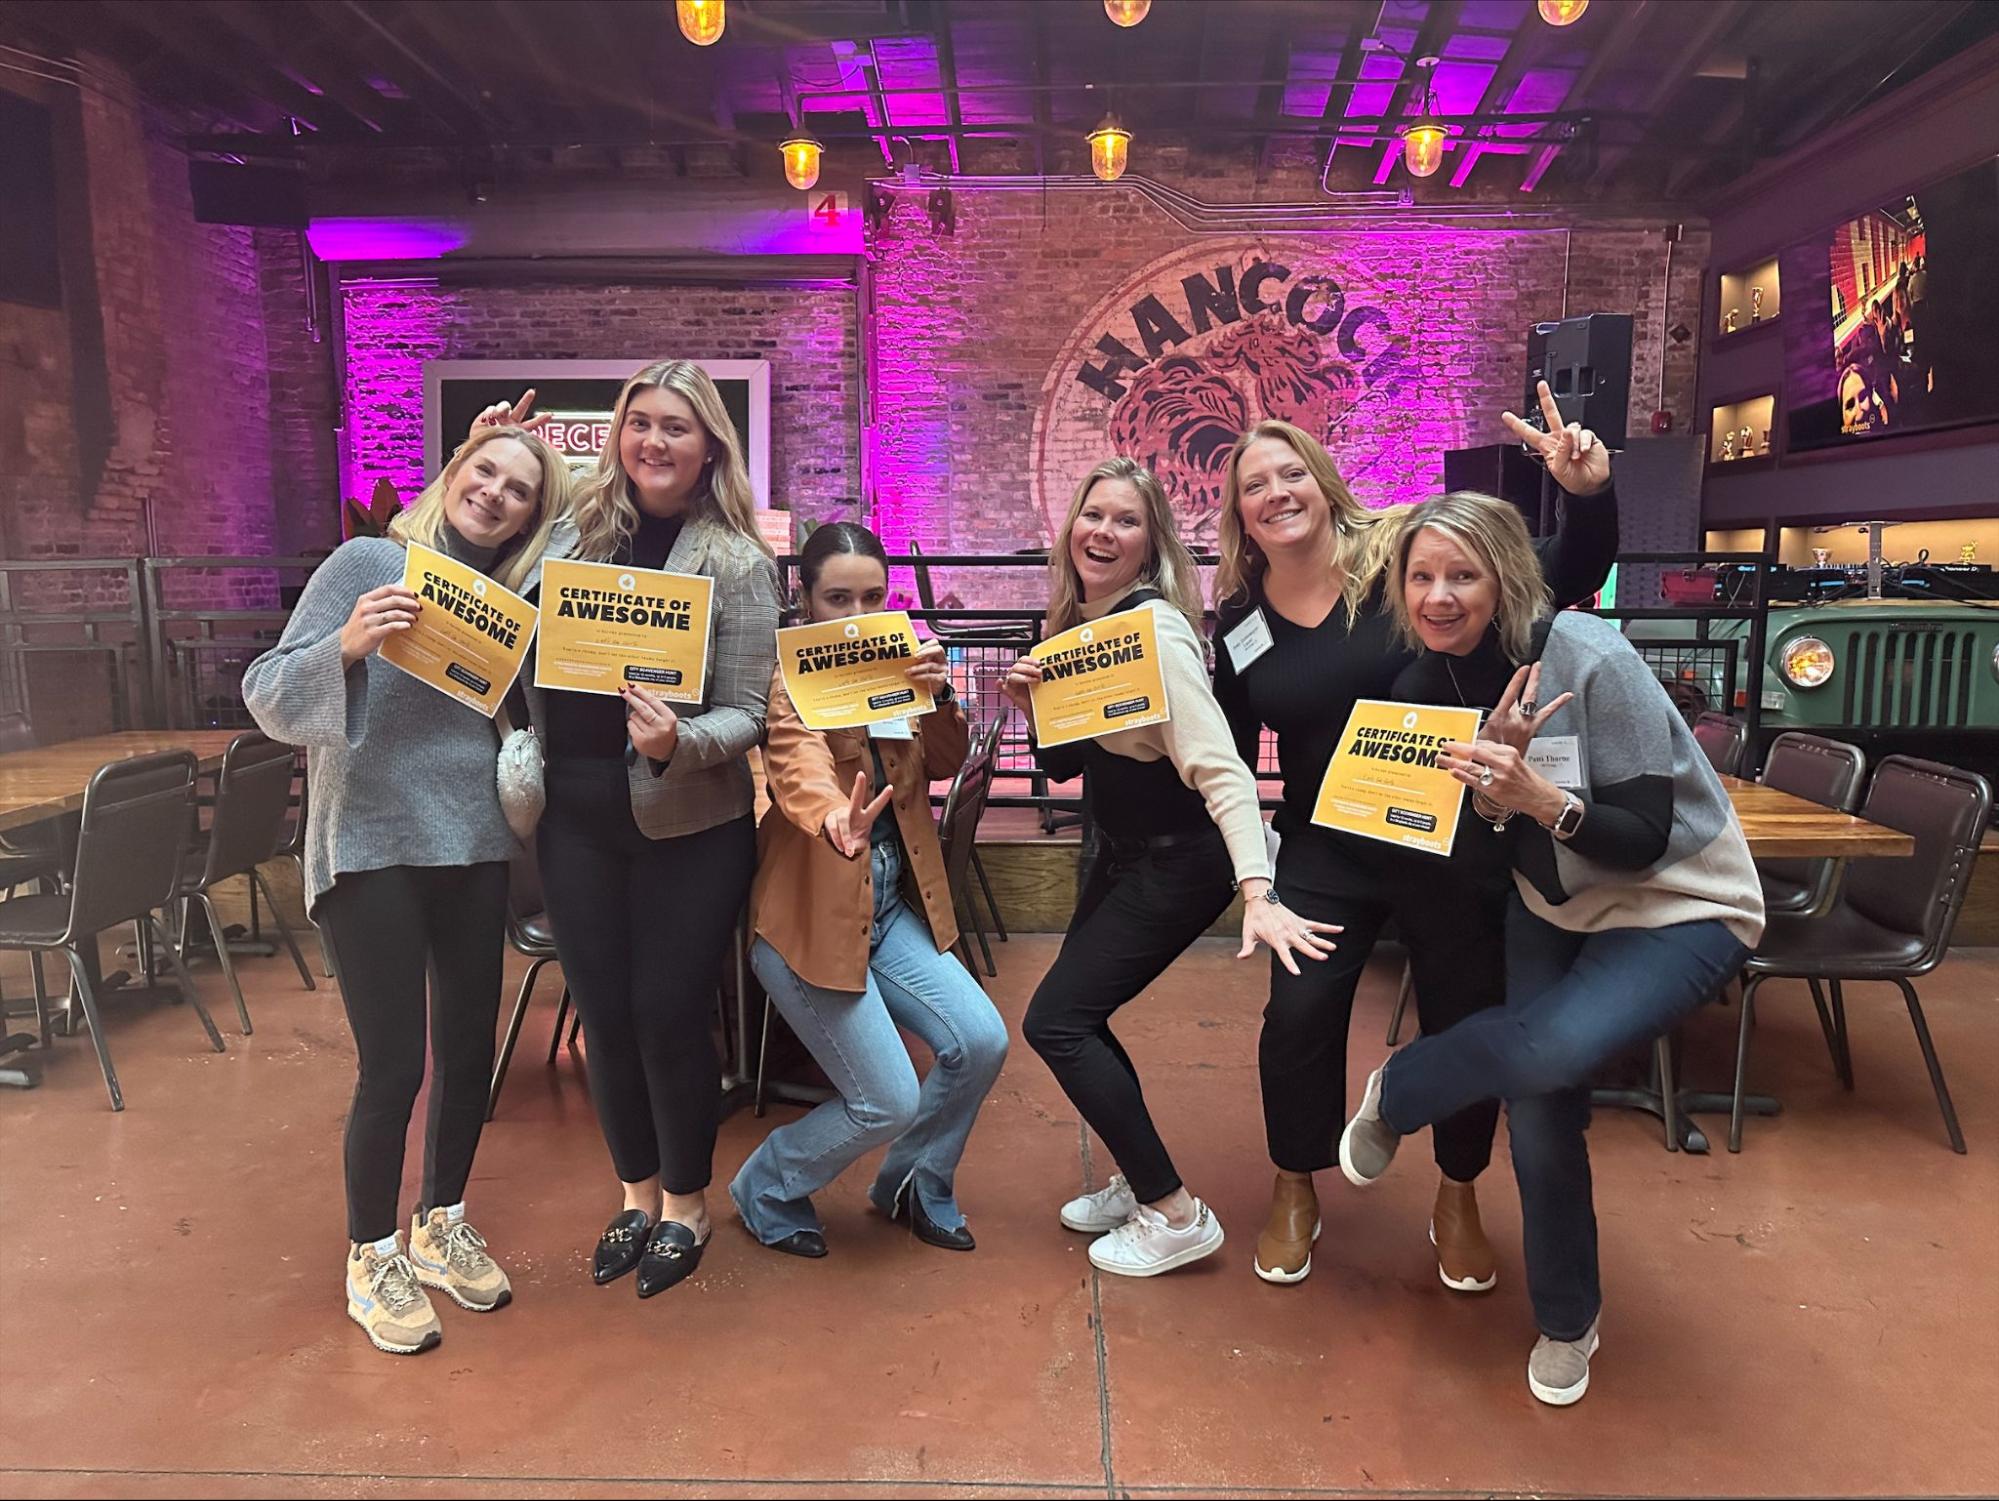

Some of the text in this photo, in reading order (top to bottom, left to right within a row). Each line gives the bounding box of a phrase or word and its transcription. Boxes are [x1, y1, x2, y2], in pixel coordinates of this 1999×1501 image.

[814, 193, 841, 227] 4
[531, 423, 612, 452] ECE
[420, 582, 518, 650] AWESOME
[423, 571, 521, 632] CERTIFICATE OF
[557, 599, 691, 631] AWESOME
[560, 587, 692, 612] CERTIFICATE OF
[796, 632, 905, 659] CERTIFICATE OF
[798, 642, 912, 675] AWESOME
[1040, 632, 1140, 666] CERTIFICATE OF
[1041, 643, 1144, 683] AWESOME
[1356, 727, 1435, 747] CERTIFICATE
